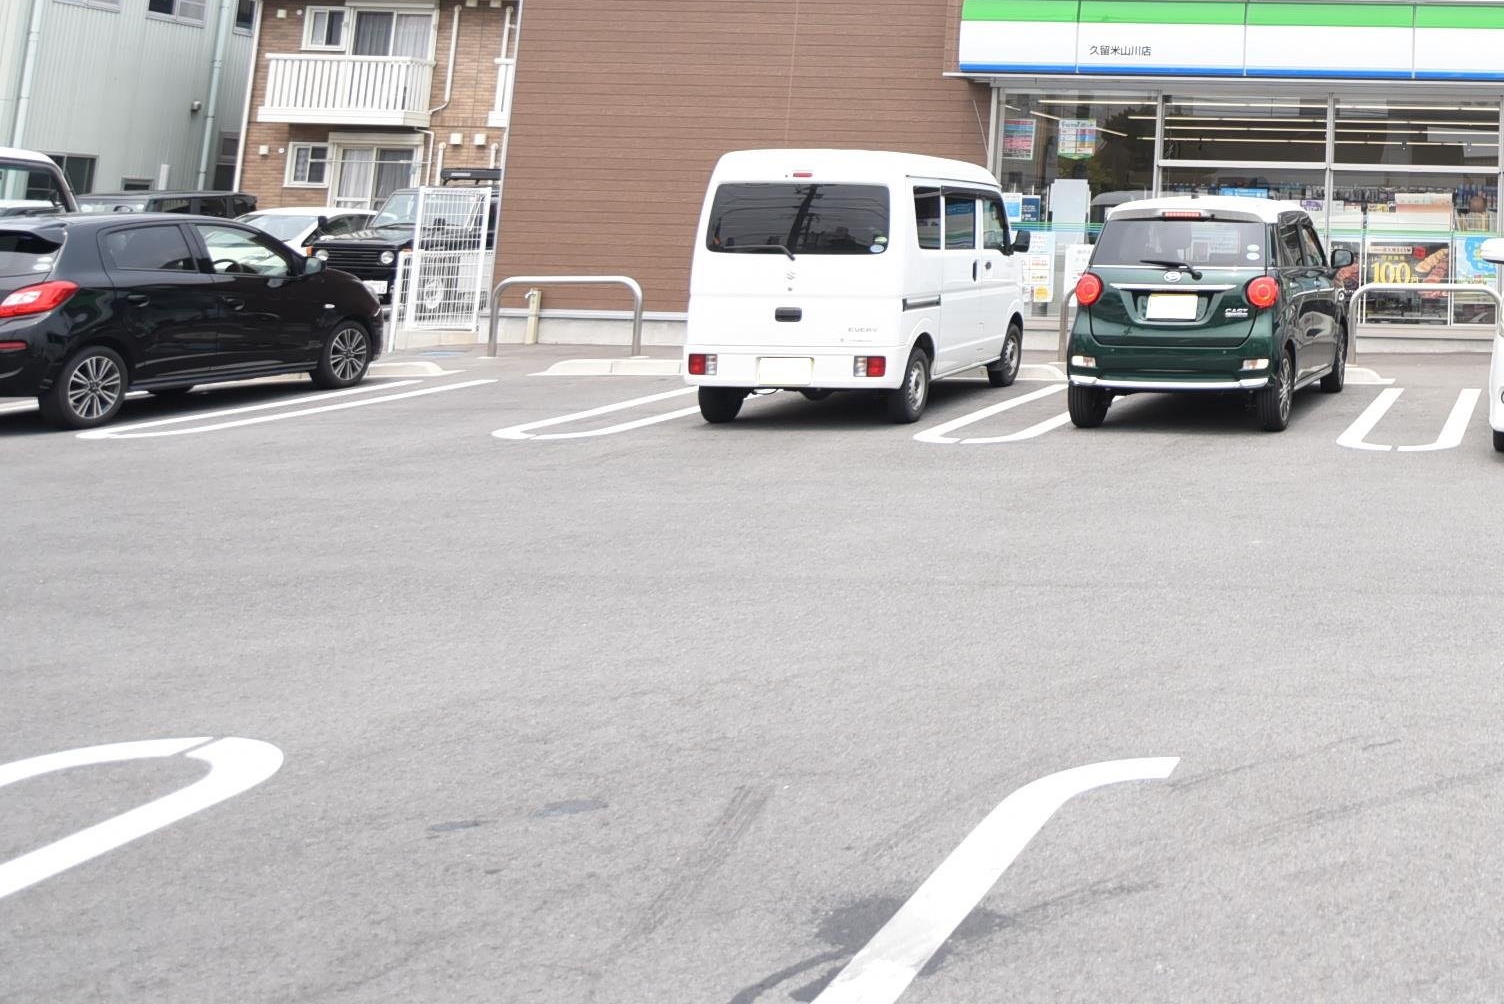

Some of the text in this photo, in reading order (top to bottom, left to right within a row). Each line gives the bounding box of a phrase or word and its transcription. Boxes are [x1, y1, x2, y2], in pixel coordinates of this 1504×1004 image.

[1089, 45, 1152, 56] 久留米山川店
